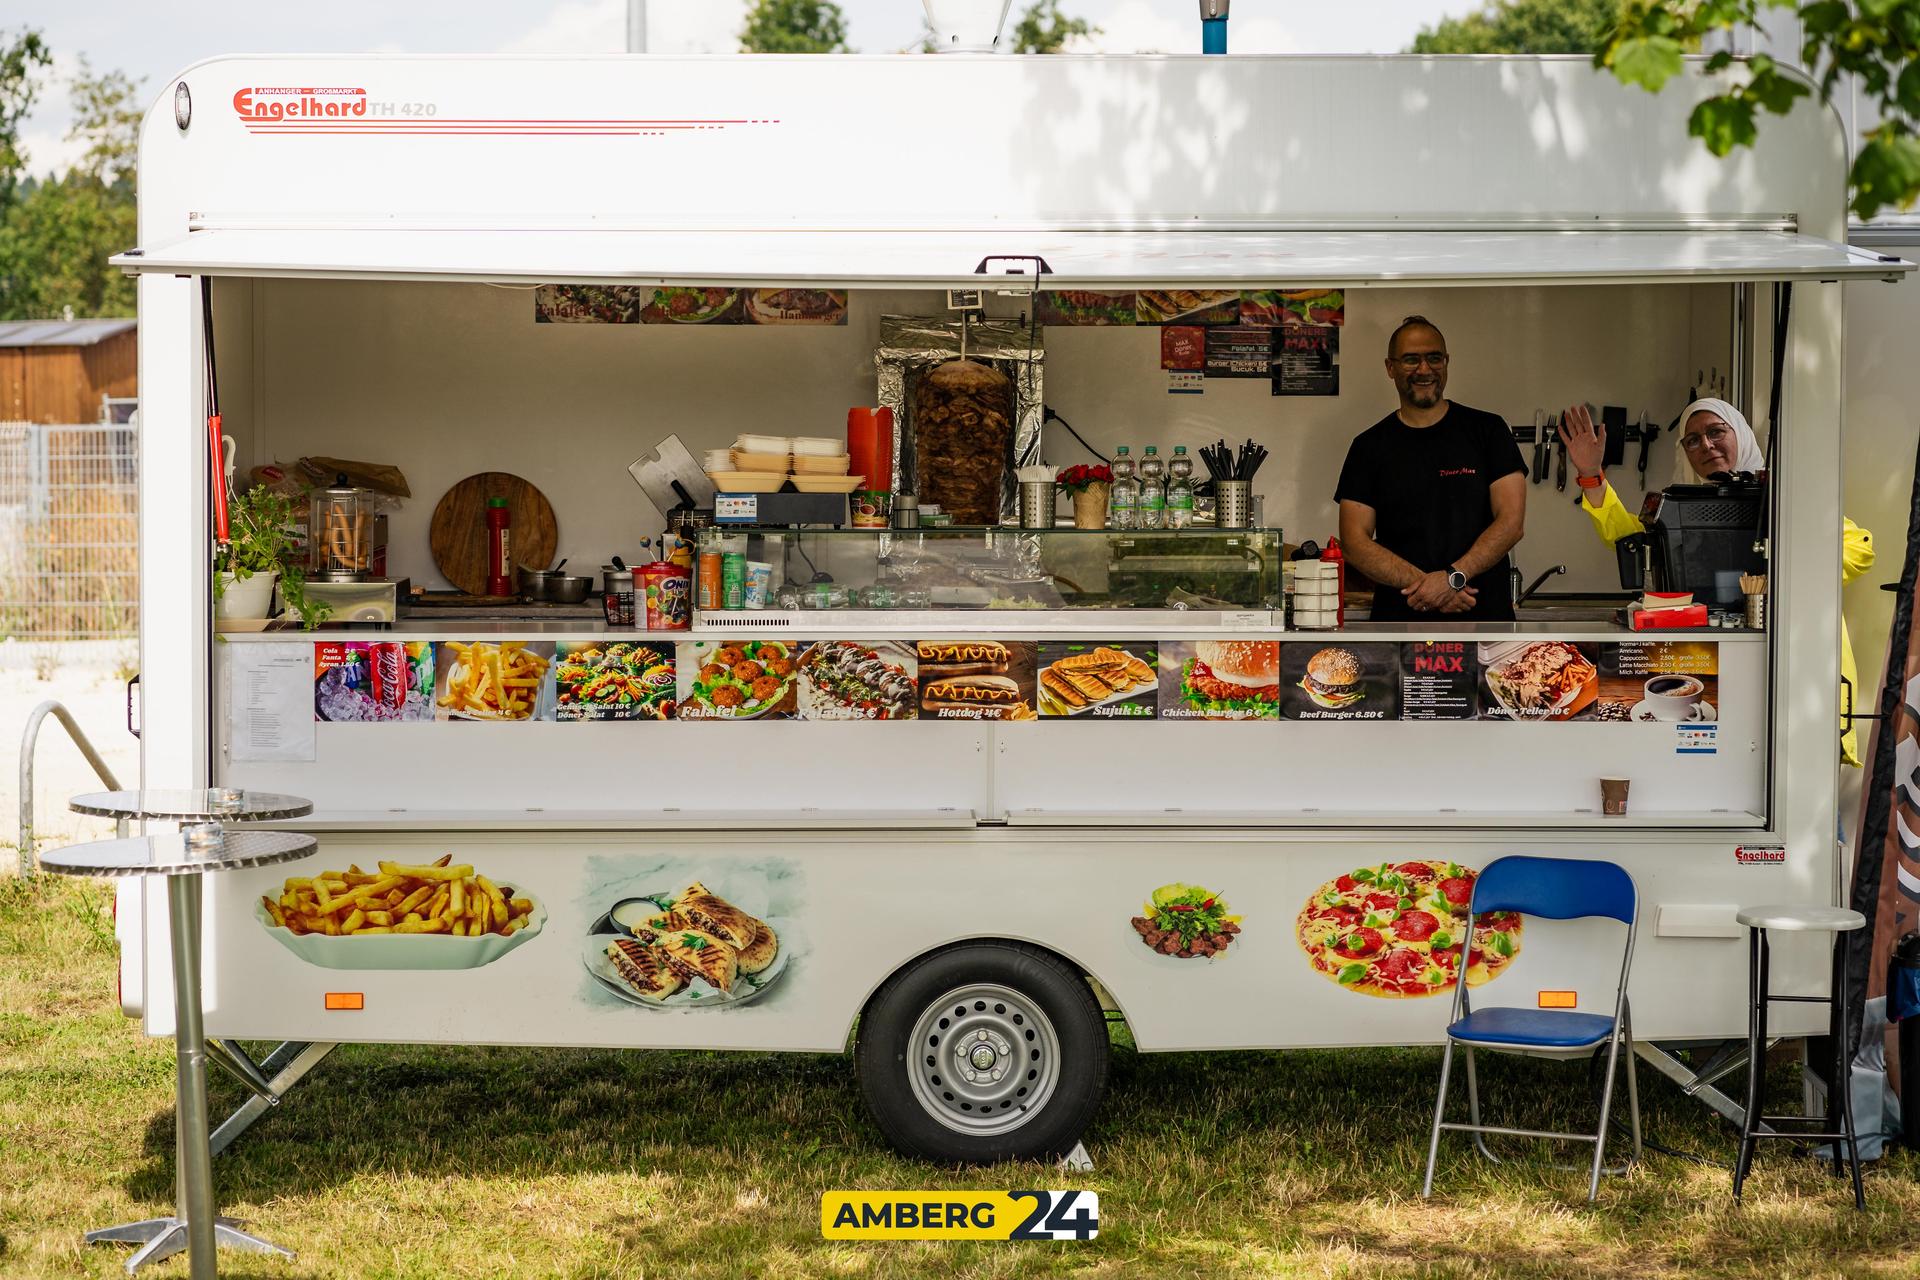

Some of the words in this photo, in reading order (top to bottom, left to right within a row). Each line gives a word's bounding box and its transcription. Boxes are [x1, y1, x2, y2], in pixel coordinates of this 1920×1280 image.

[233, 88, 367, 122] Engelhard
[368, 103, 395, 117] TH
[400, 102, 437, 117] 420
[1415, 655, 1464, 673] MAX
[681, 705, 737, 718] Falafel
[938, 707, 984, 719] Hotdog
[1092, 705, 1132, 717] Sujuk
[1162, 708, 1205, 717] Chicken
[1206, 708, 1244, 719] Burger
[1300, 711, 1321, 719] Beef
[1321, 711, 1354, 720] Burger
[1355, 711, 1376, 719] 6.50
[1487, 706, 1519, 715] Döner
[1520, 707, 1549, 715] Teller
[1735, 846, 1785, 862] Engelhard
